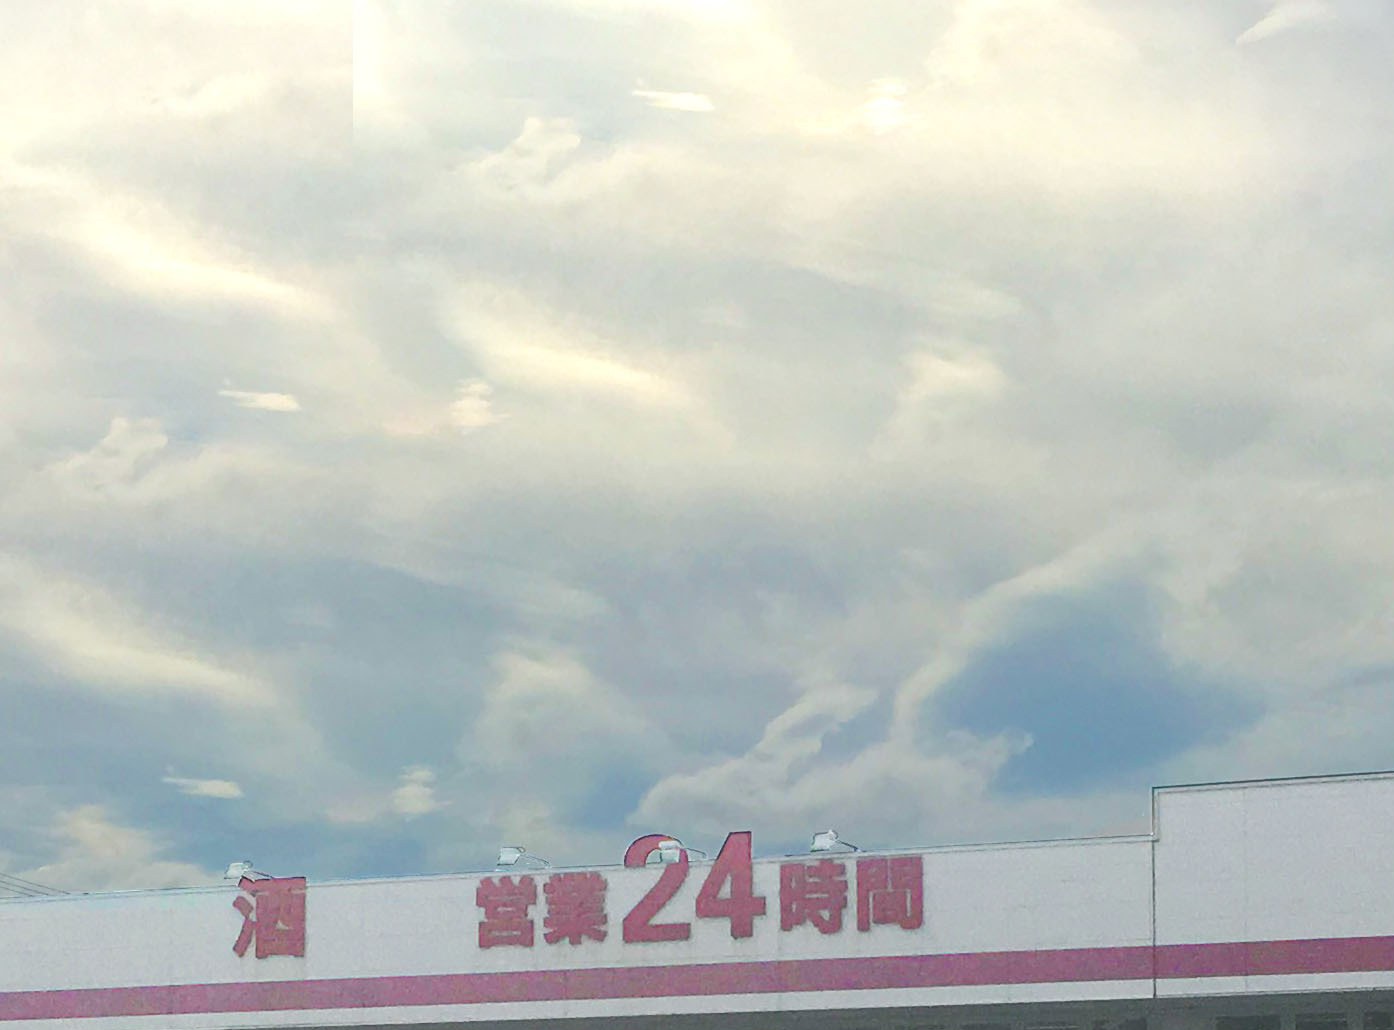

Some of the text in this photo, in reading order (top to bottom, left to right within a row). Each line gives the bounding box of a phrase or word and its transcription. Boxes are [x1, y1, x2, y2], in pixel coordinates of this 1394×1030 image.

[232, 876, 308, 960] 酒
[474, 830, 925, 949] 営業24時間
